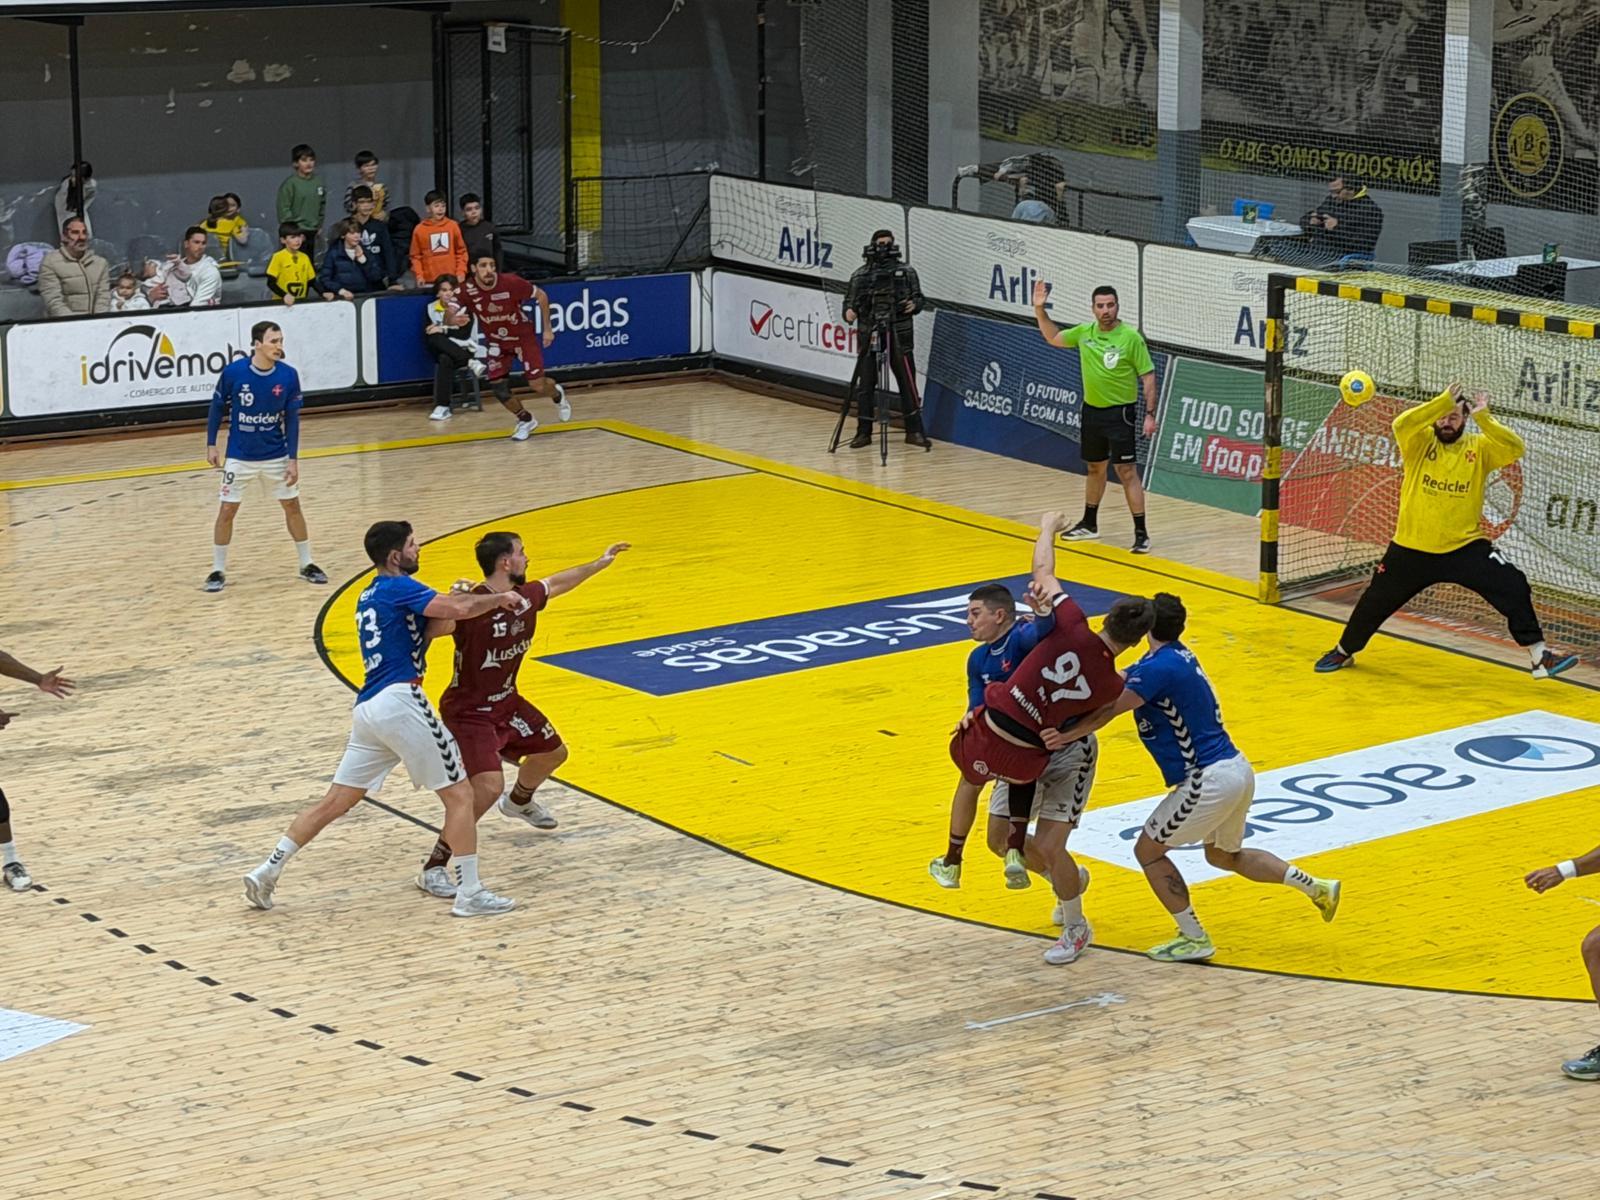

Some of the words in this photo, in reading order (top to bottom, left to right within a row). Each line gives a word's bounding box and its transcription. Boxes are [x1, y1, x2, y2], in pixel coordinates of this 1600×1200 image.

[778, 226, 833, 269] Arliz
[585, 330, 630, 348] Saúde
[238, 392, 254, 407] 19
[963, 388, 1013, 417] SABSEG
[1026, 382, 1036, 396] O
[1036, 384, 1077, 405] FUTURO
[1023, 400, 1031, 417] É
[1031, 404, 1054, 421] COM
[1054, 409, 1065, 424] A
[1066, 411, 1081, 428] SA
[1180, 396, 1233, 433] TUDO
[1236, 408, 1310, 449] SORE
[1169, 432, 1201, 464] EM
[1206, 437, 1262, 482] fpa.p
[1422, 473, 1471, 493] Recicle!
[492, 622, 507, 638] 15
[632, 636, 737, 658] Saúde
[1040, 651, 1092, 703] 97
[541, 722, 555, 740] 15
